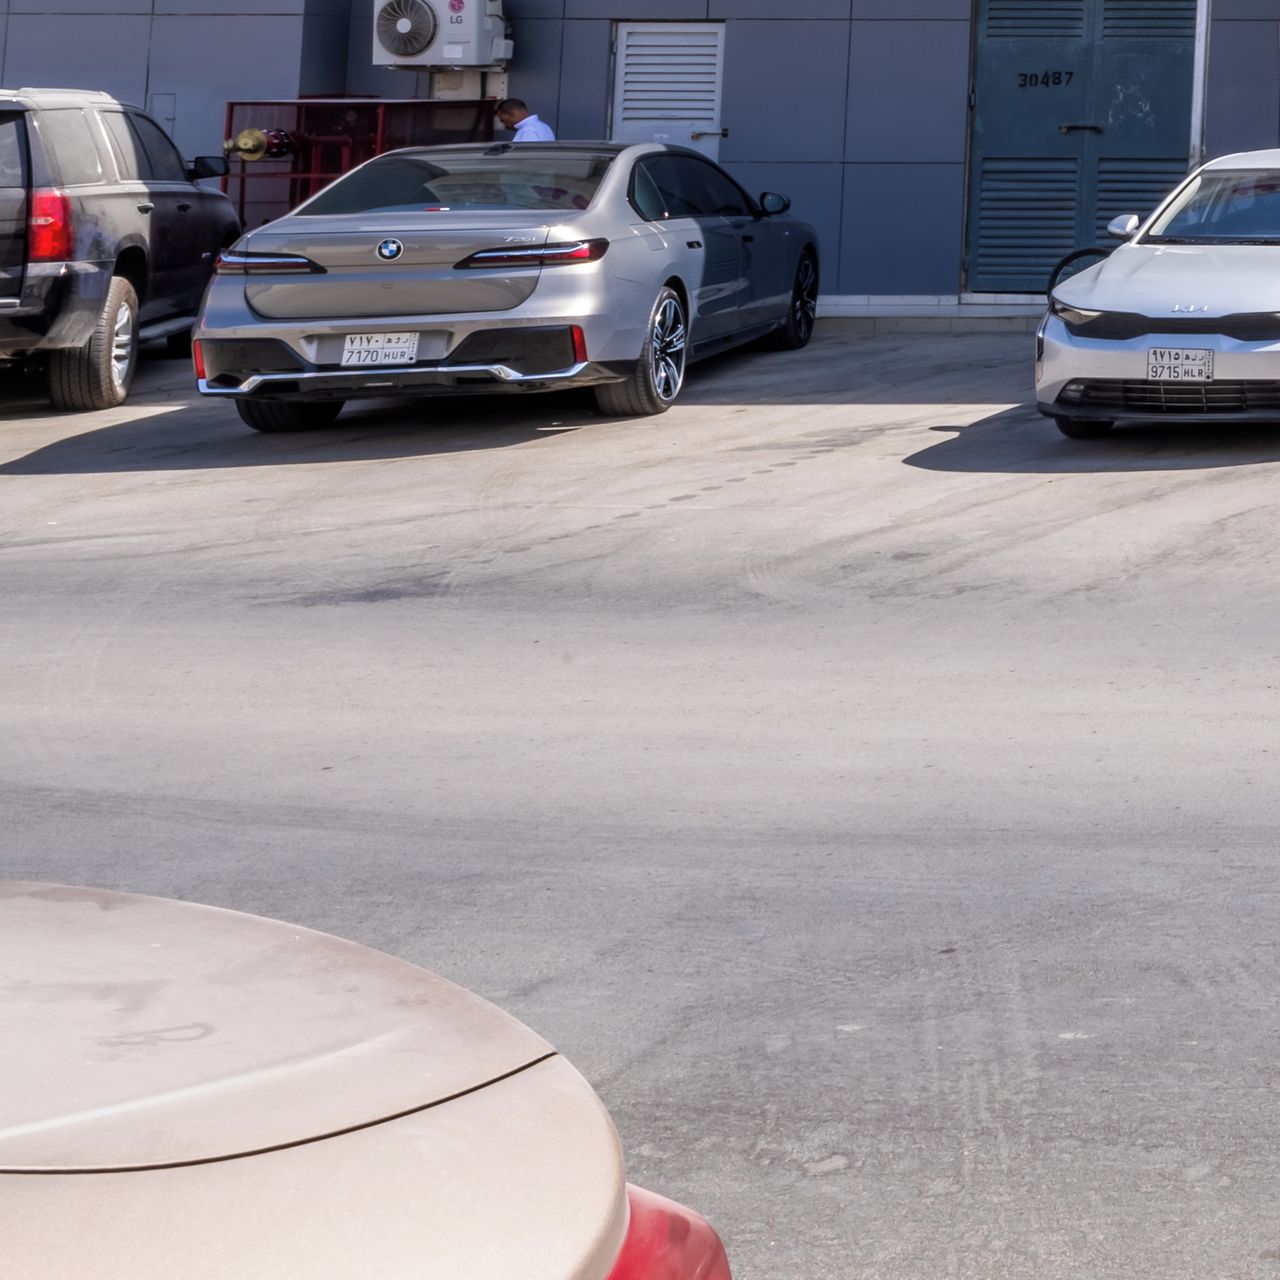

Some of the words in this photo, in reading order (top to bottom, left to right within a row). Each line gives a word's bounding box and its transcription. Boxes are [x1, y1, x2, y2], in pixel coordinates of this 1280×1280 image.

[450, 15, 463, 24] LG
[1018, 70, 1074, 88] 30487
[345, 349, 379, 363] 7170
[384, 351, 407, 360] HUR
[1151, 365, 1180, 379] 9715
[1184, 368, 1204, 378] HLR
